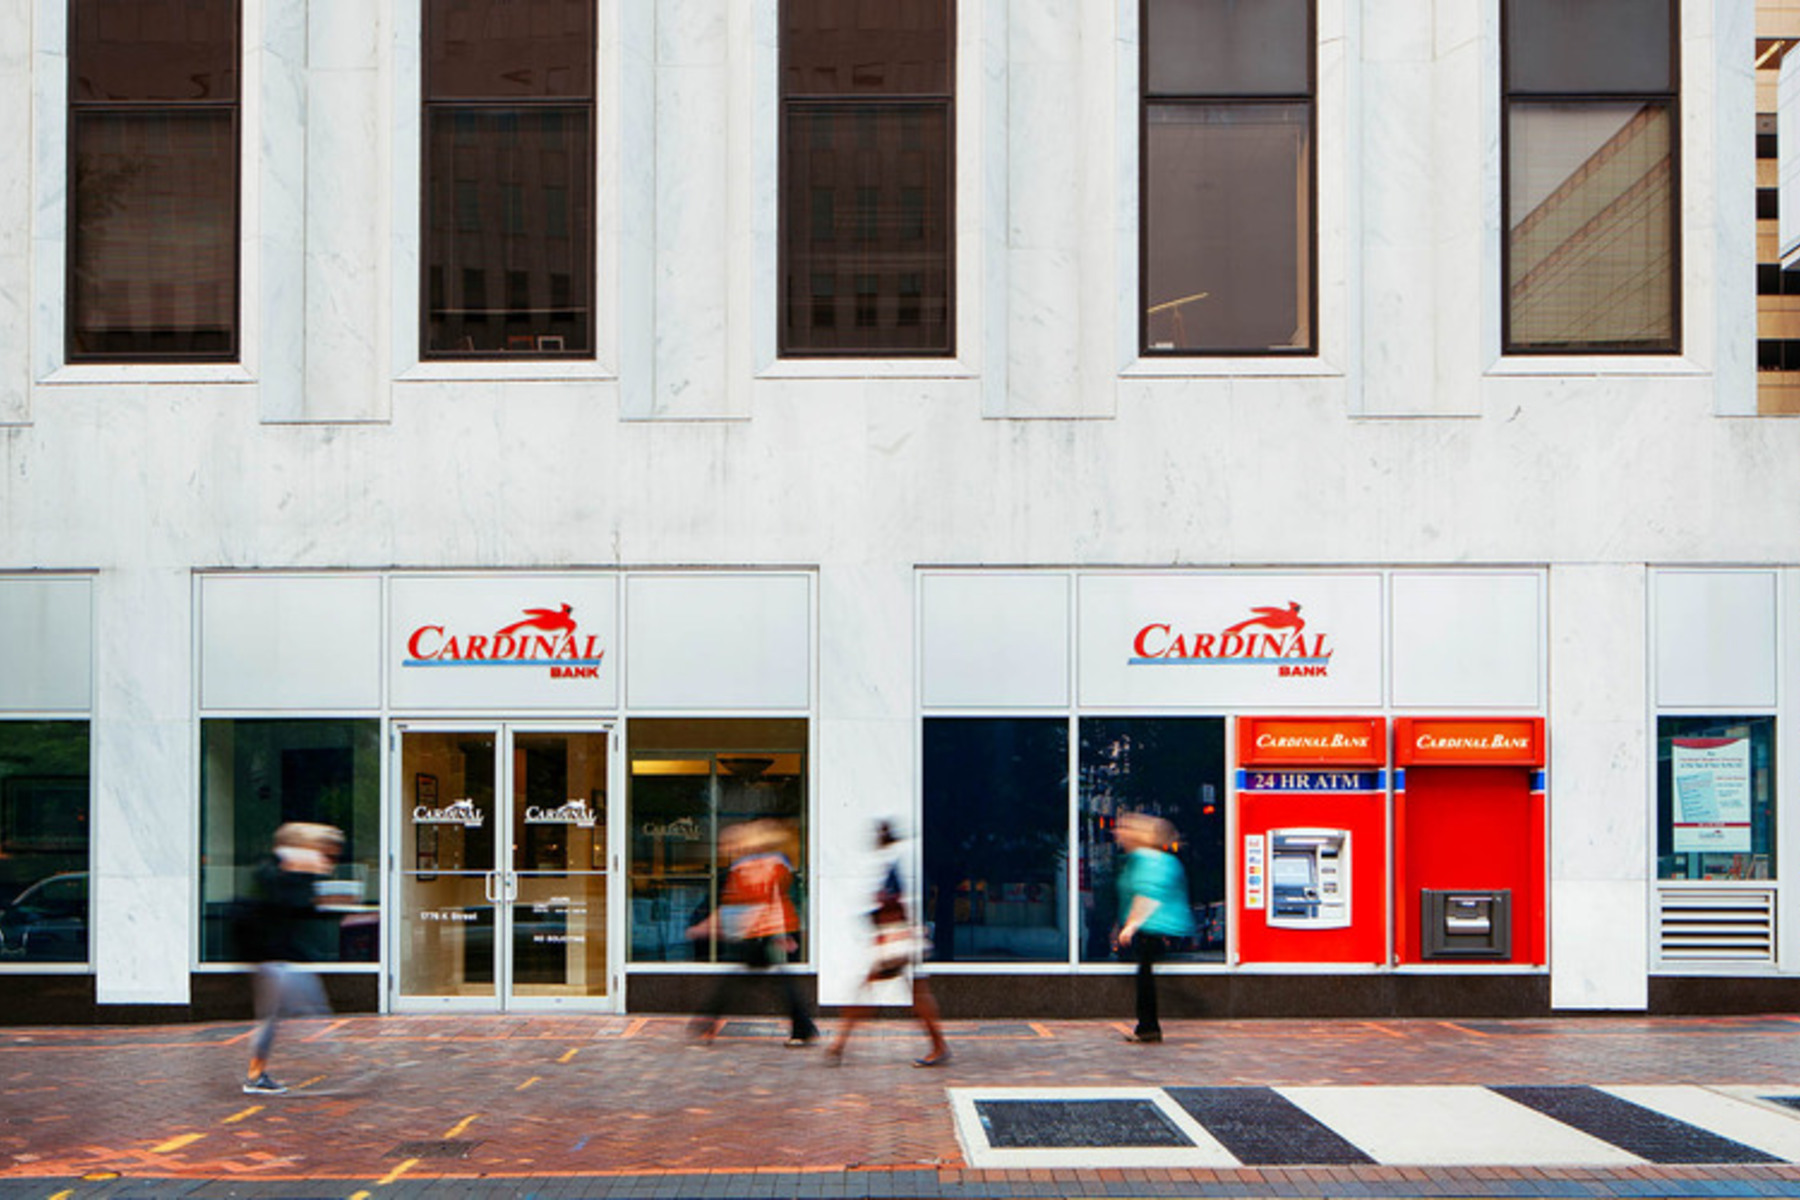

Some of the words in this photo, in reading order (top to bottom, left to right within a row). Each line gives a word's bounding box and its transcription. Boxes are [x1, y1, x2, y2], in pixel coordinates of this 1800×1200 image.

[407, 625, 604, 660] CARDINAL
[1133, 623, 1333, 658] CARDINAL
[550, 667, 599, 679] BANK
[1278, 666, 1327, 677] BANK
[1256, 734, 1329, 748] CARDINAL
[1329, 734, 1369, 748] BANK
[1416, 735, 1490, 749] CARDINAL
[1490, 734, 1530, 748] BANK
[1255, 774, 1275, 789] 24
[1280, 774, 1311, 789] HR
[1314, 774, 1360, 789] ATM
[413, 806, 484, 820] CARDINAL
[525, 806, 597, 820] CARDINAL
